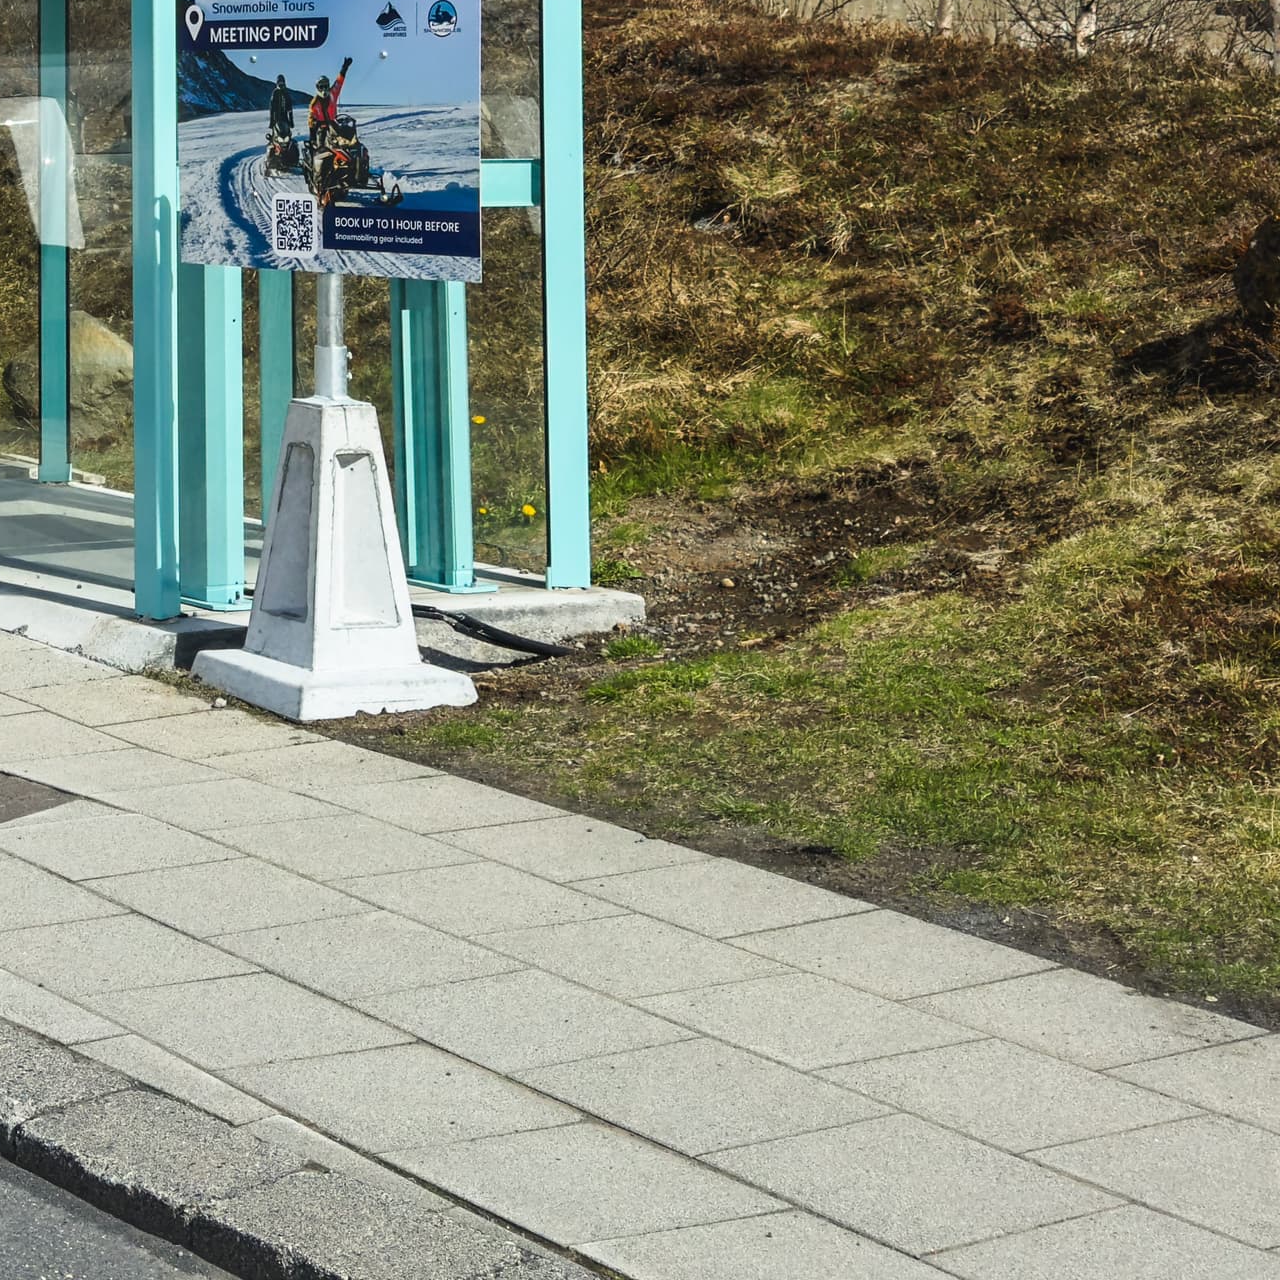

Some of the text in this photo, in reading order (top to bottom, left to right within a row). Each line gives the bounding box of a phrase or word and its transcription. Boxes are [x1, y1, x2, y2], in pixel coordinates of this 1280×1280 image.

[212, 0, 315, 14] Snowmobile Tours
[210, 25, 317, 43] MEETING POINT
[335, 217, 460, 233] BOOK UP TO 1 HOUR BEFORE
[335, 233, 423, 244] Snowmobiling gear included
